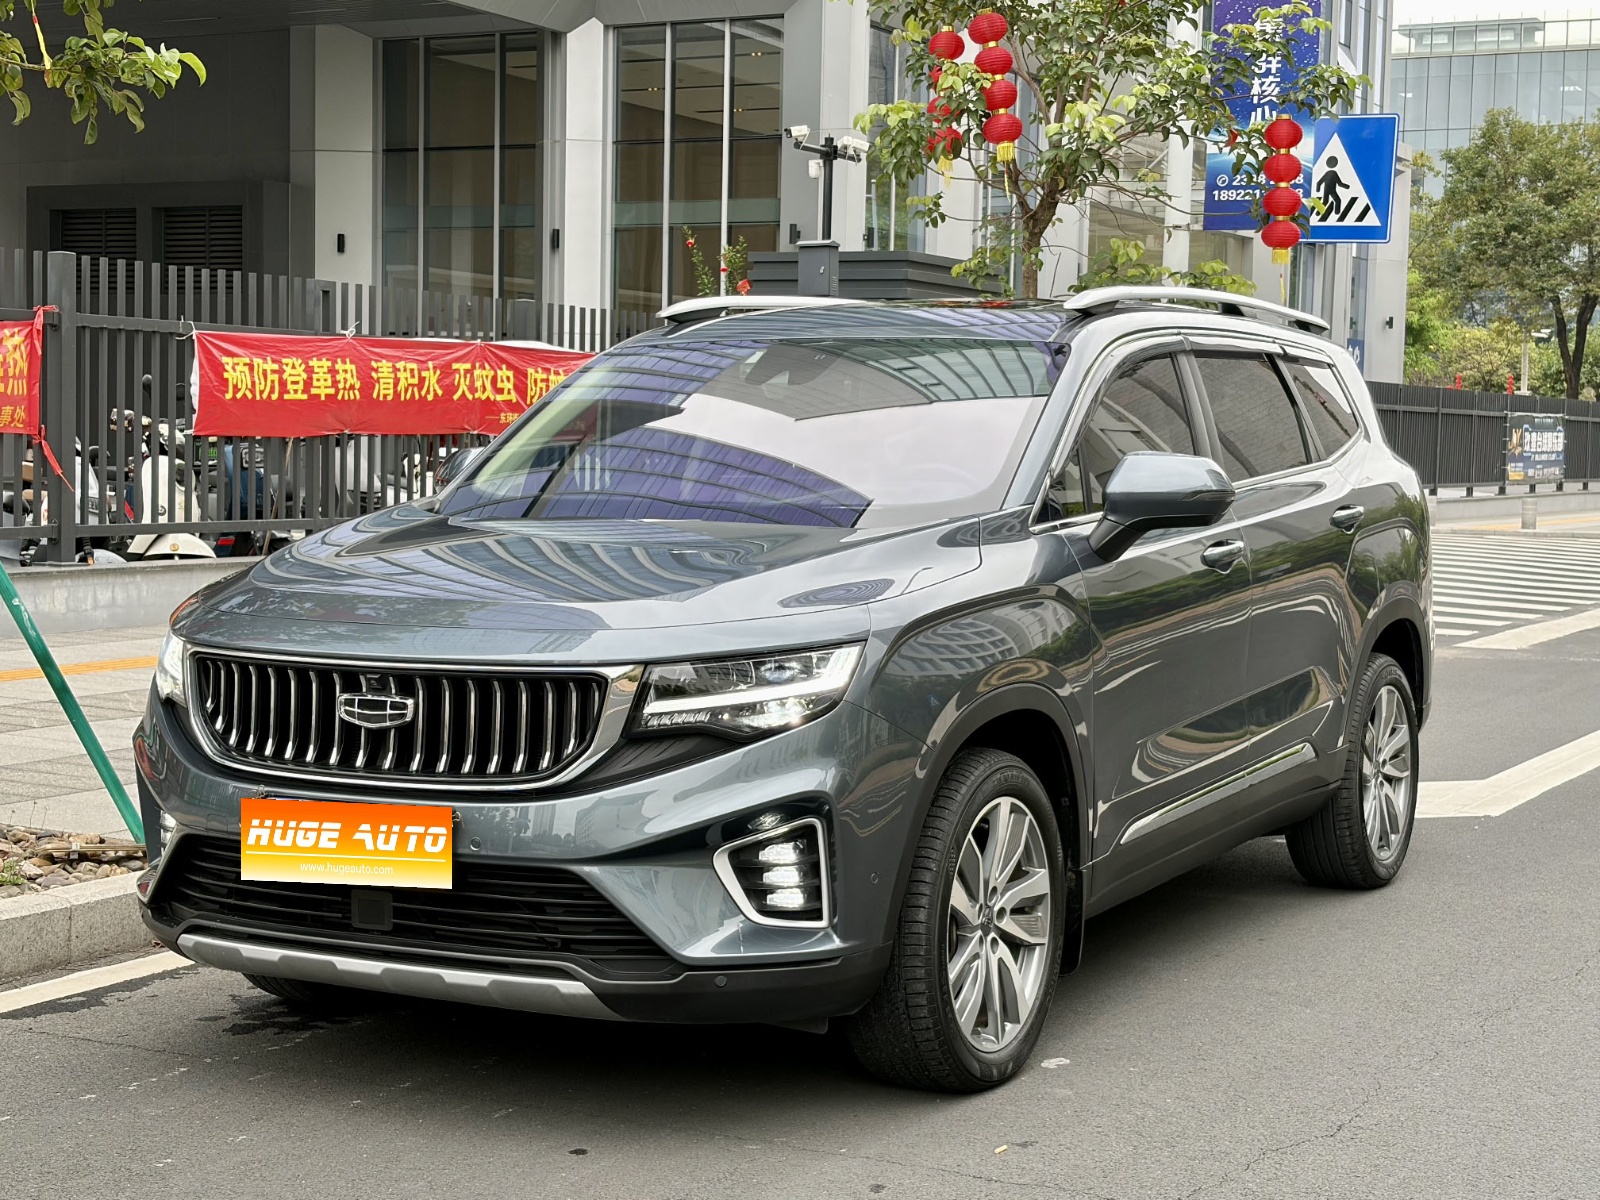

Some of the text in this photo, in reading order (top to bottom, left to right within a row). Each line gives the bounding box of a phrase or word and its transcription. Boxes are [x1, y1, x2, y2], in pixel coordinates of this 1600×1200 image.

[0, 328, 28, 396] 热
[222, 357, 361, 401] 预防登革热
[371, 360, 443, 401] 清积水
[452, 361, 517, 403] 灭蚊虫
